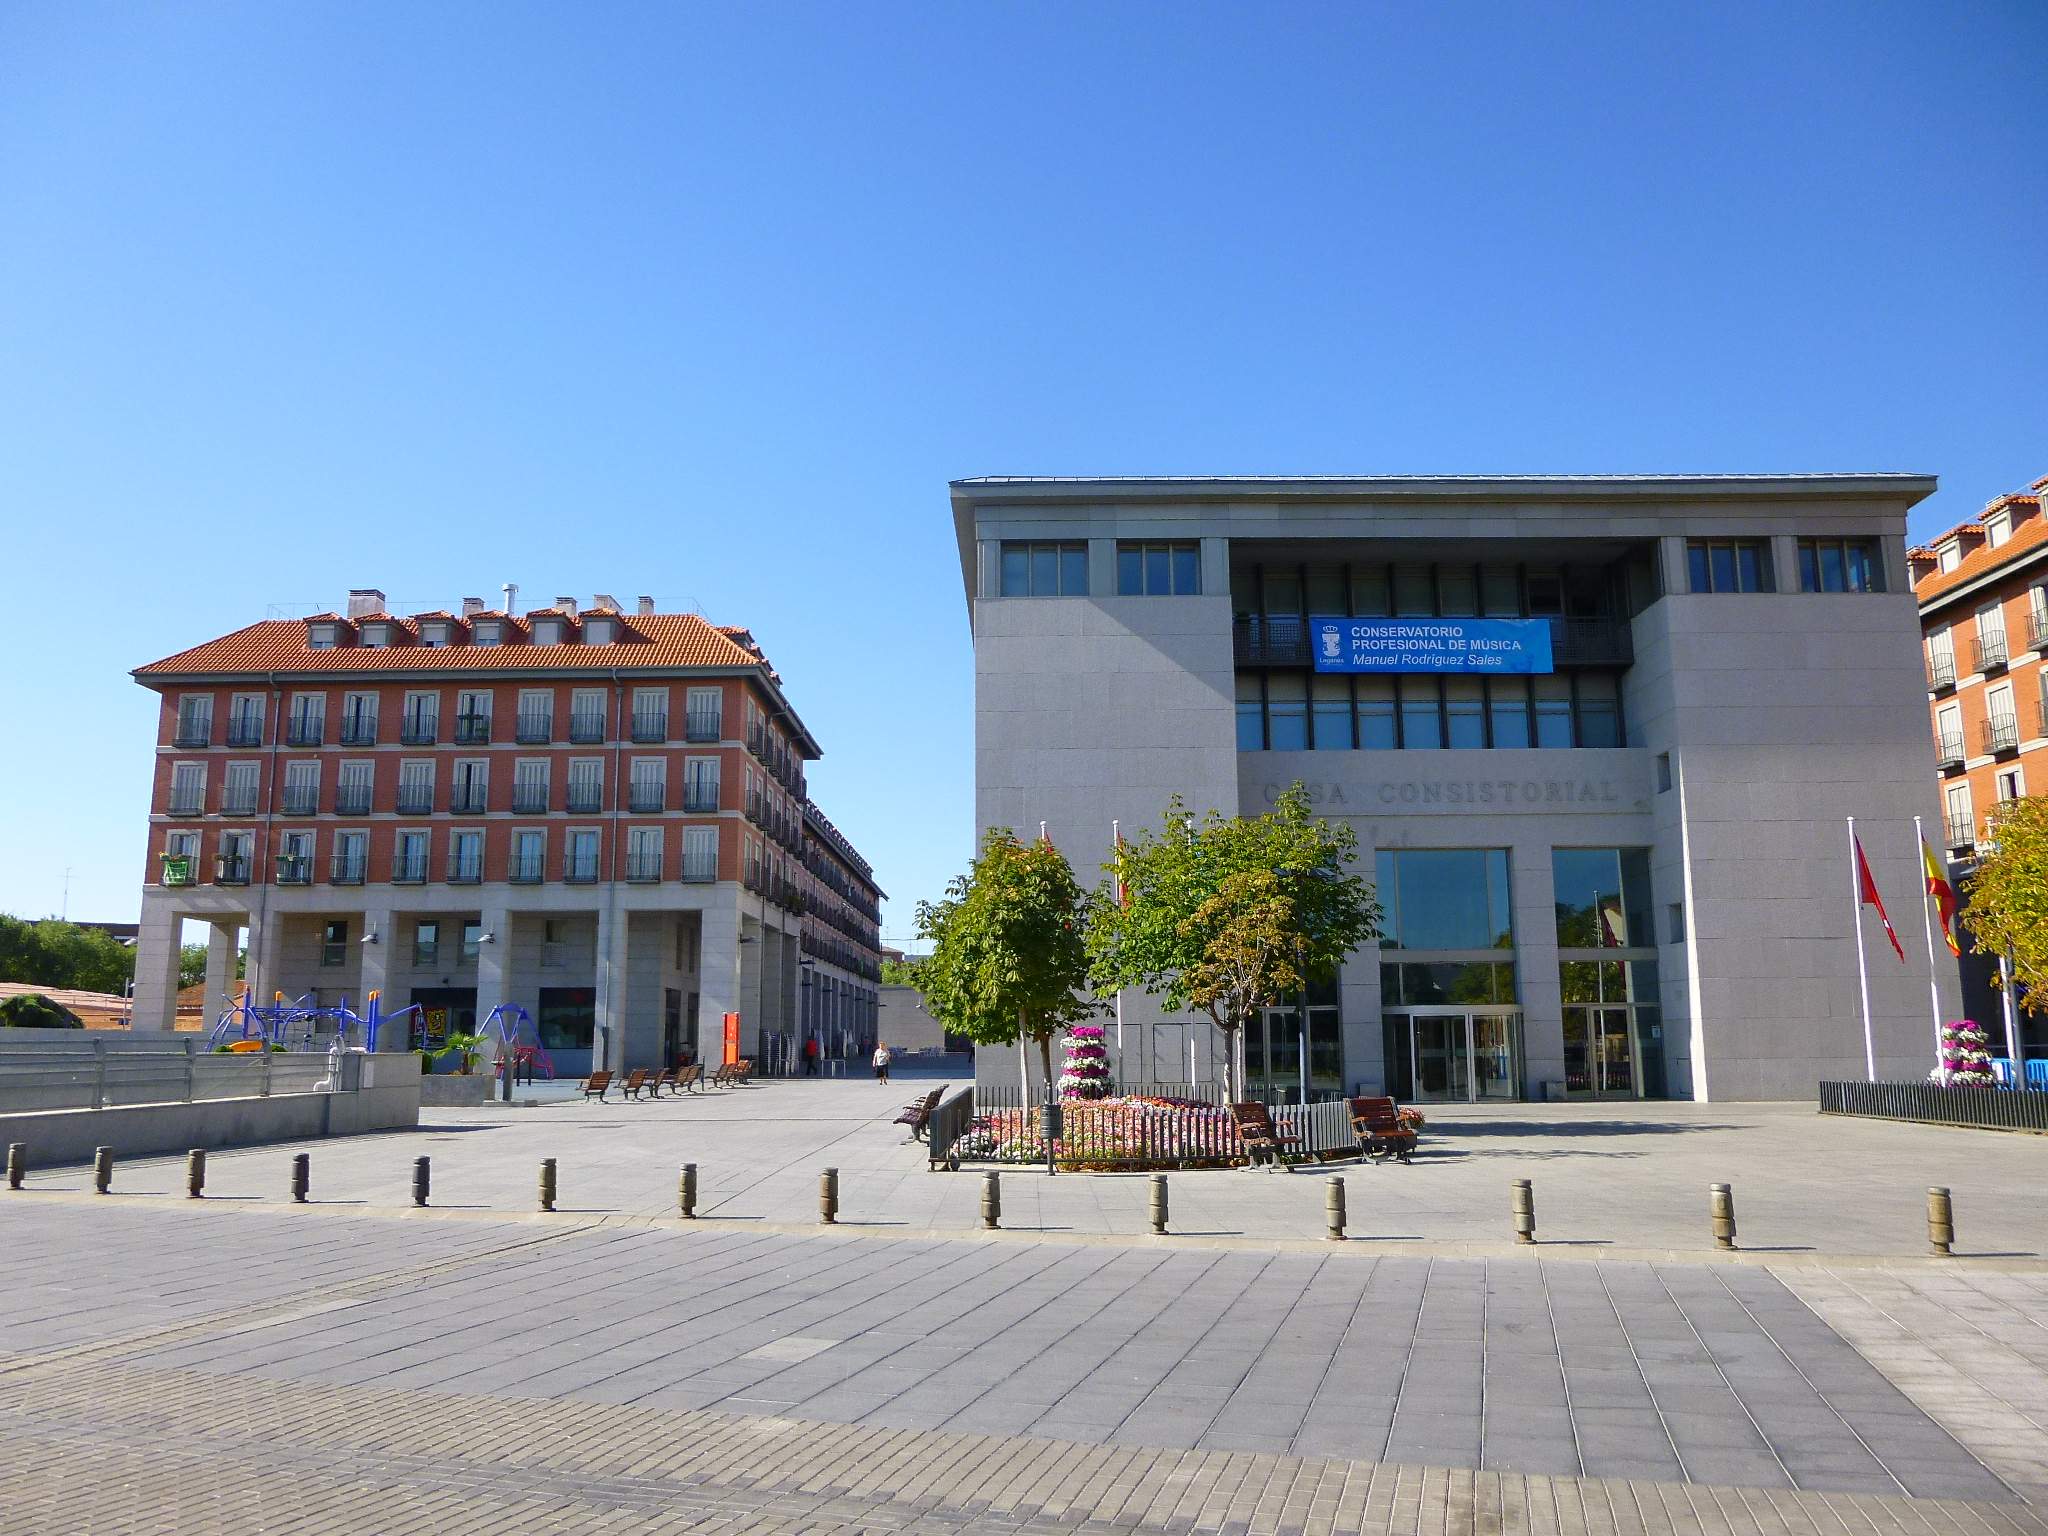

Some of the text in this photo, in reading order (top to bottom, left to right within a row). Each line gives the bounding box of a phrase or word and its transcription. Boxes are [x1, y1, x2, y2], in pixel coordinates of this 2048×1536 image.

[1352, 626, 1463, 638] CONSERVATORIO
[1352, 637, 1522, 651] PROFESIONAL DE MÚSICA
[1353, 653, 1398, 665] Manuel
[1467, 653, 1502, 665] Sales
[1264, 781, 1619, 804] CSA CONSISTORIAL
